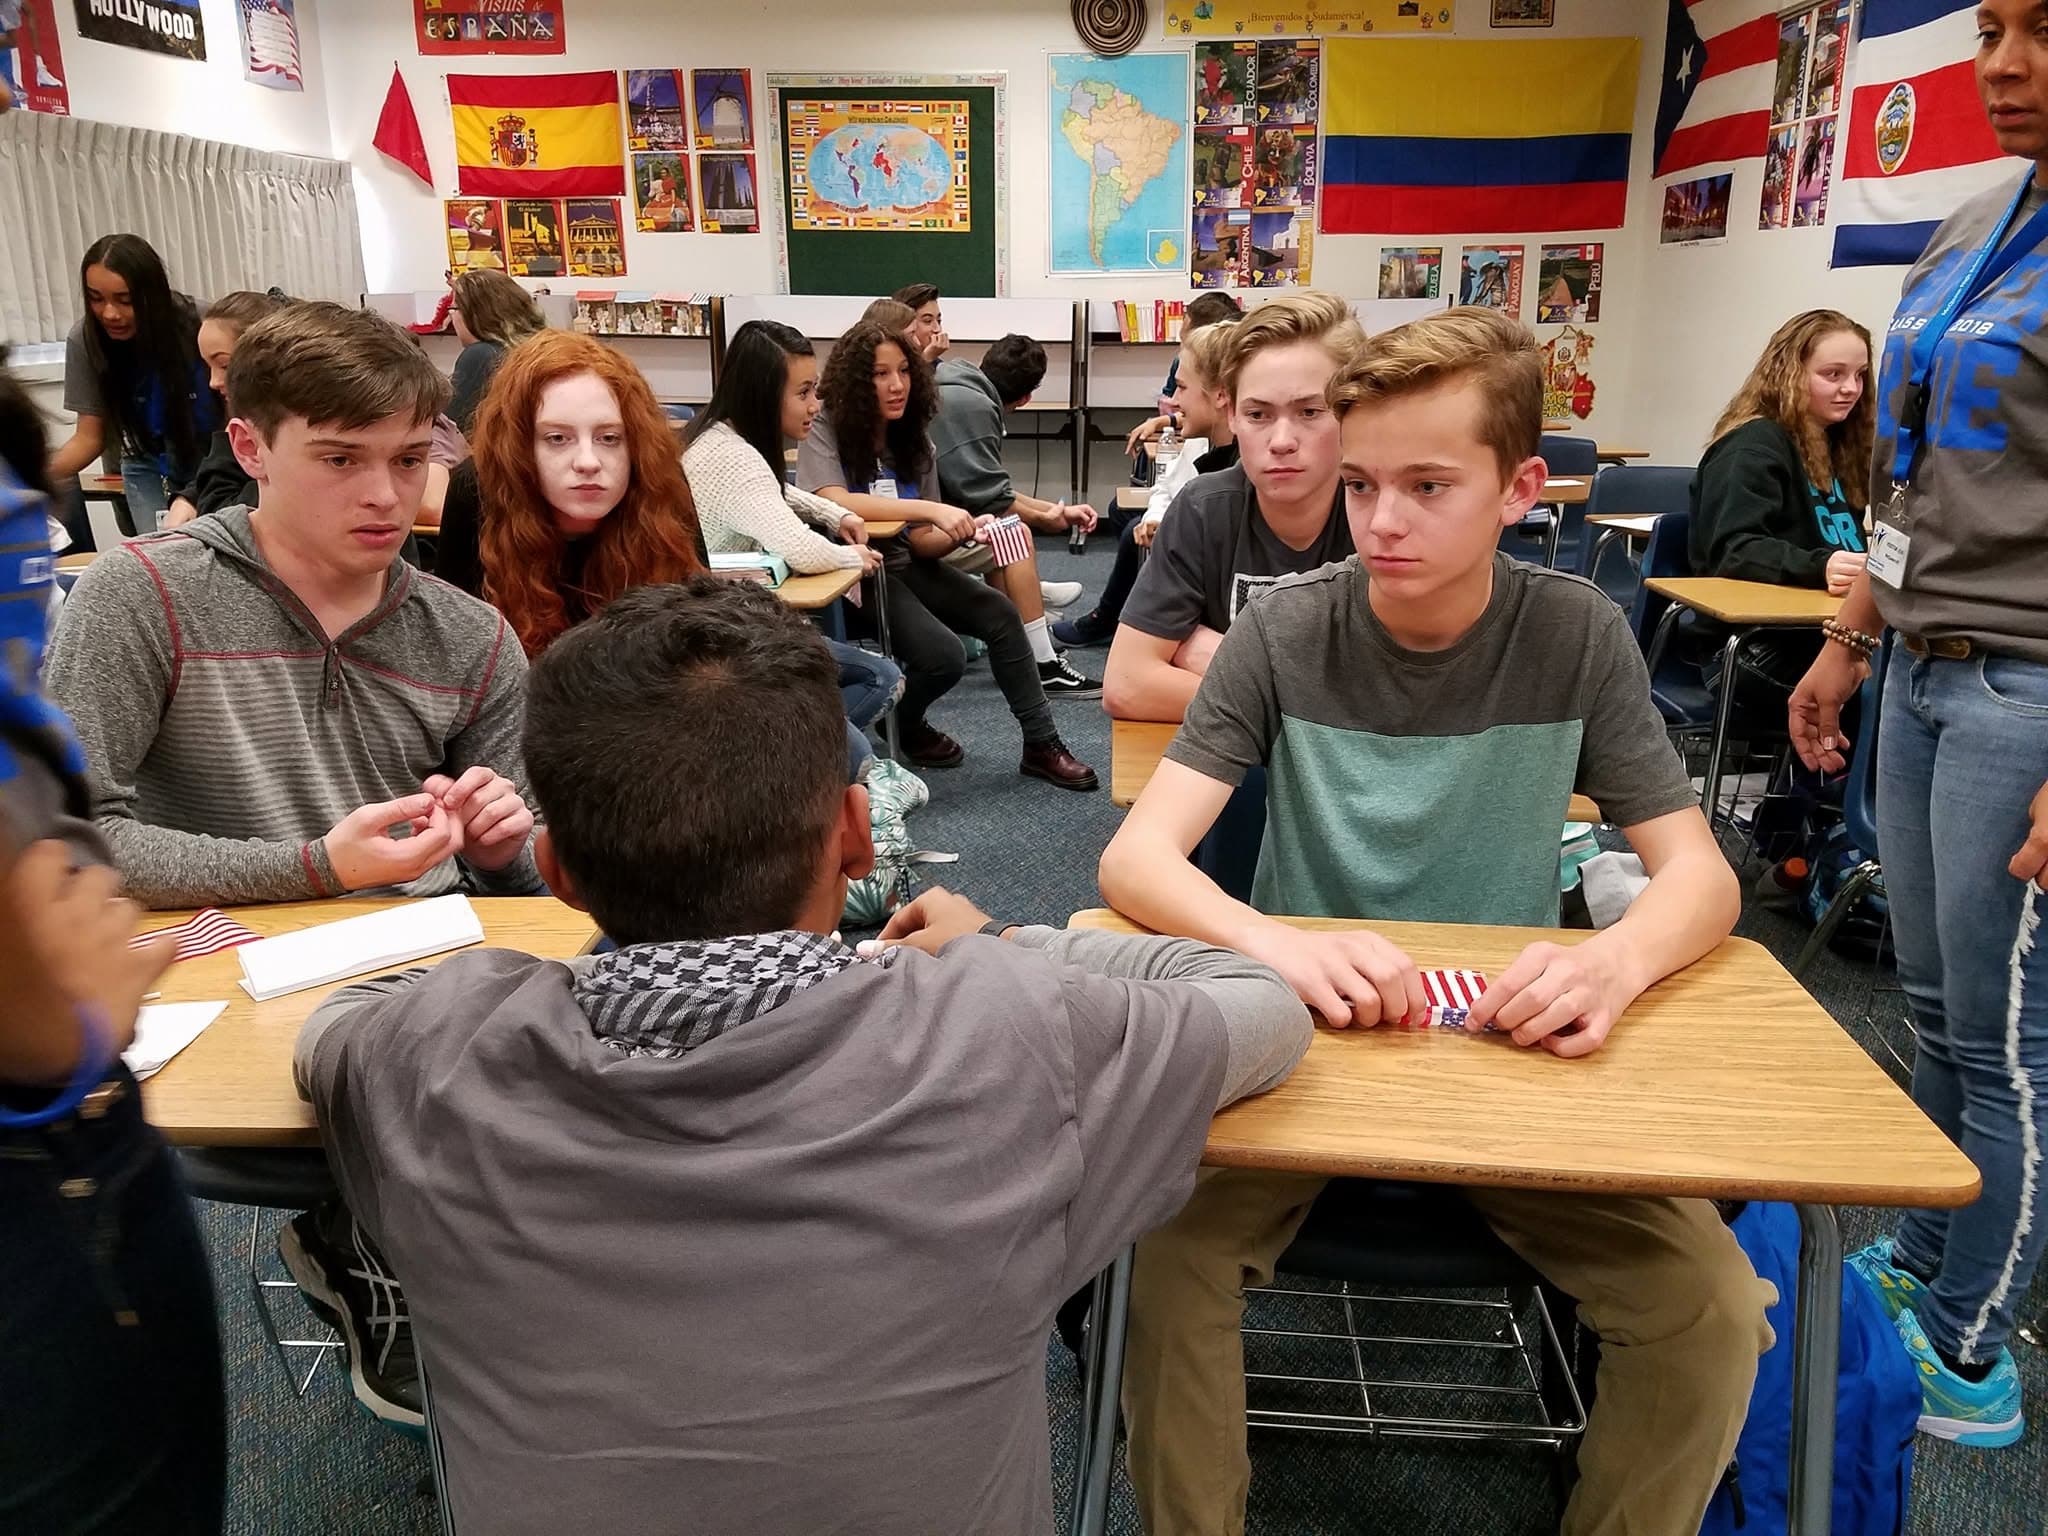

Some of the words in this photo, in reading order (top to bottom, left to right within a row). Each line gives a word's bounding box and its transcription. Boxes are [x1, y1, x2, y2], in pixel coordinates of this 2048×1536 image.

[90, 0, 195, 40] HOLLYWOOD
[427, 13, 553, 39] ESPAÑA
[1244, 55, 1256, 109] ECUADOR
[1306, 57, 1318, 111] COLOMBIA
[1242, 145, 1254, 178] CHILE
[1303, 143, 1315, 186] BOLIVIA
[1820, 154, 1832, 211] BELIZE
[1239, 226, 1251, 278] ARGENTINA
[1508, 262, 1521, 313] PARAGUAY
[1949, 318, 1995, 335] 2018
